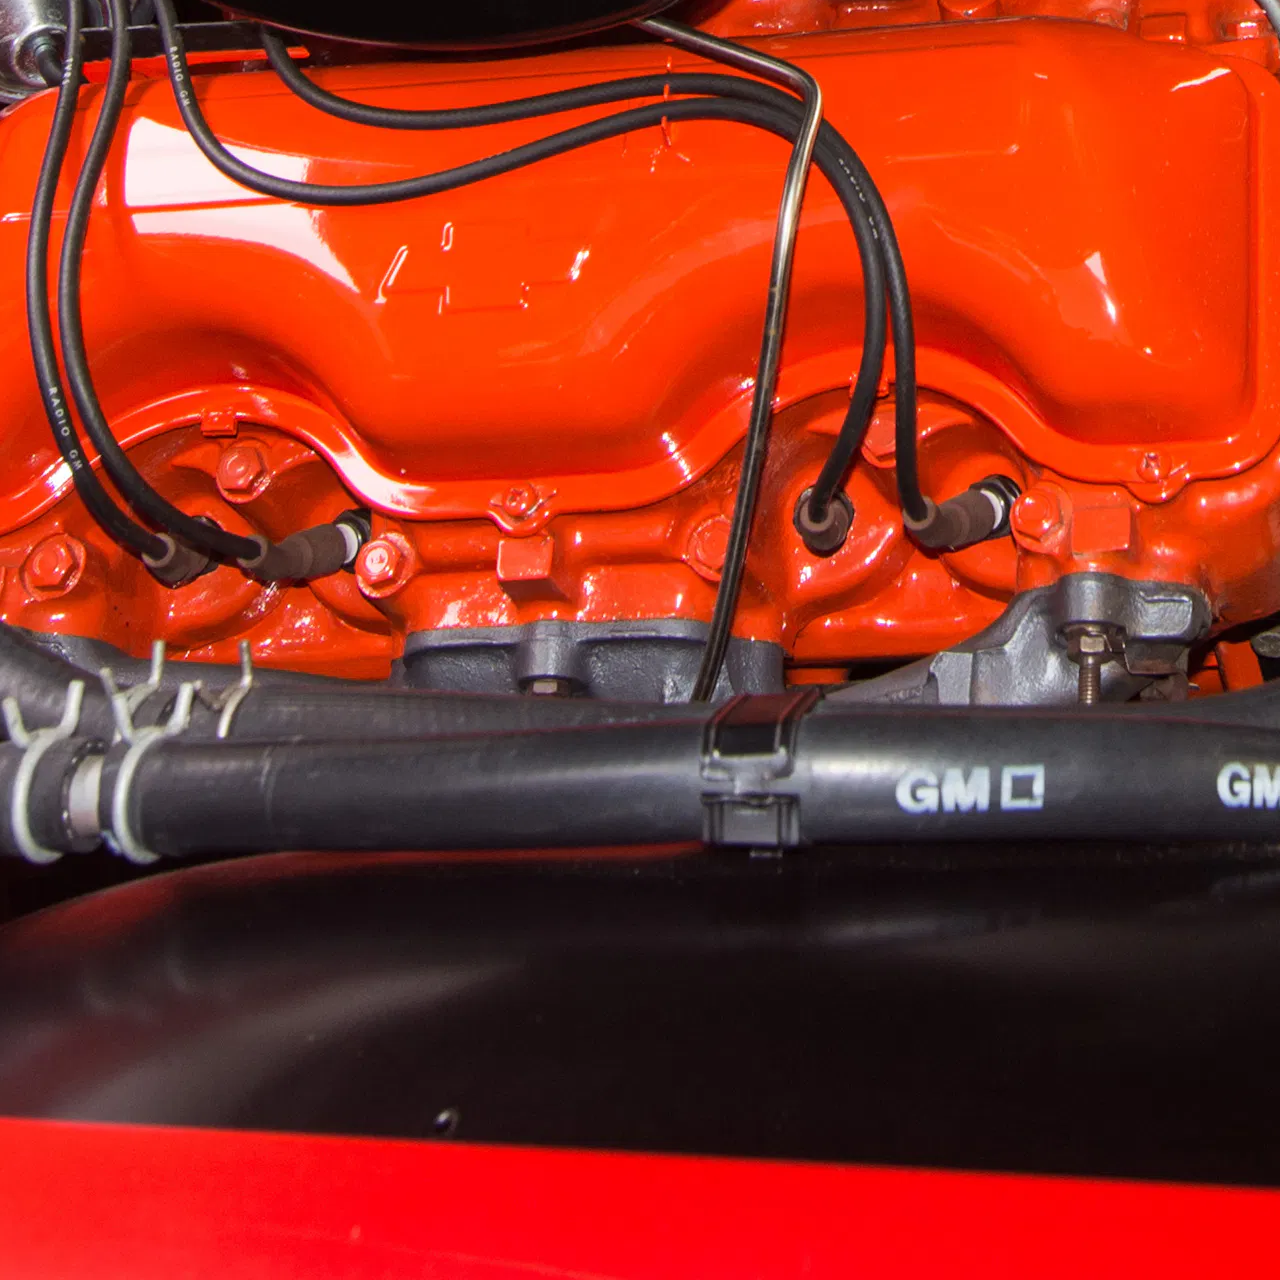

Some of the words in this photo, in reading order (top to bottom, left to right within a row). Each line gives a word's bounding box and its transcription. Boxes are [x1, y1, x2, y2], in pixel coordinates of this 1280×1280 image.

[49, 386, 70, 437] RADIO
[69, 449, 83, 471] GM
[895, 765, 990, 814] GM
